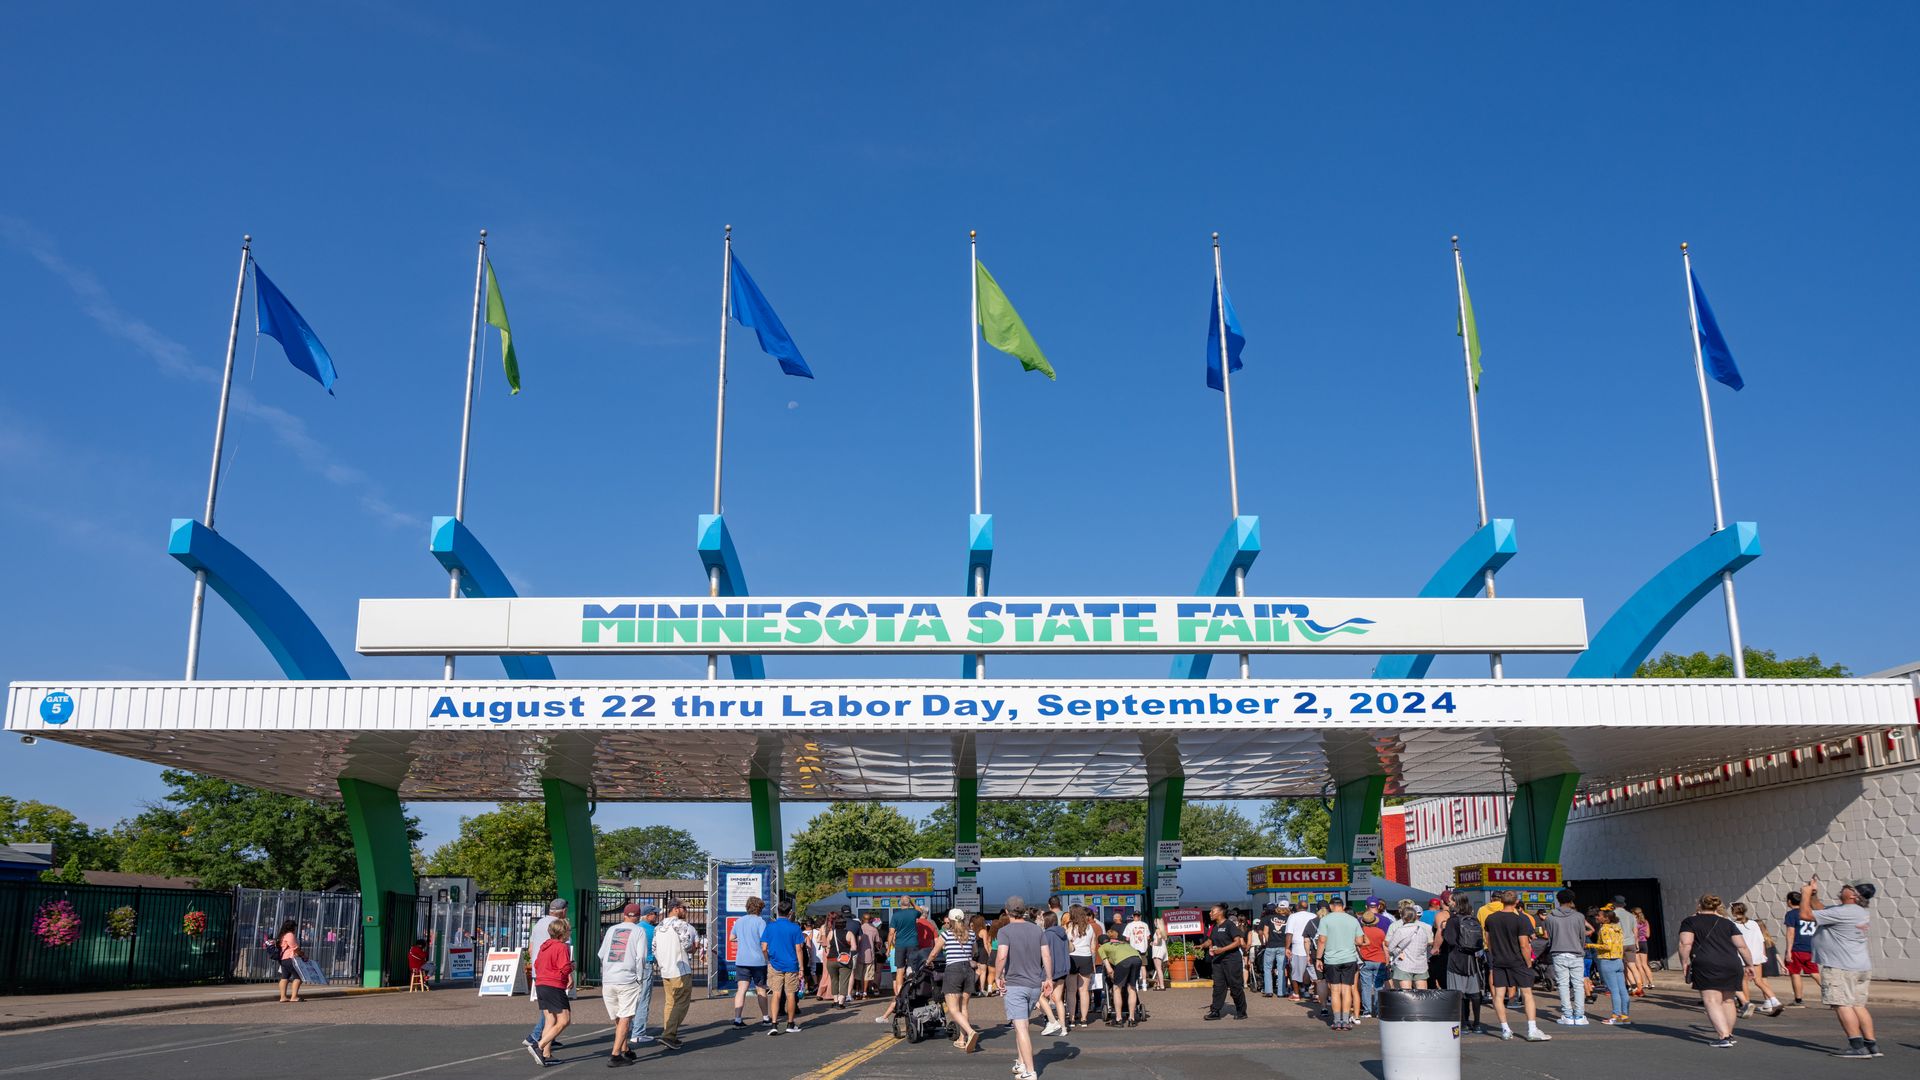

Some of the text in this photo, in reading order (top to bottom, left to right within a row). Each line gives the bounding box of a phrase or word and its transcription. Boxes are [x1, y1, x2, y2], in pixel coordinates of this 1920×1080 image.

[582, 601, 1340, 644] MINNESOTA STATE FAIR
[51, 703, 62, 714] 5
[429, 691, 1457, 724] August 22 thru Labor Day, September 2, 2024
[861, 875, 920, 886] TICKETS
[1072, 873, 1131, 884] TICKETS
[1279, 870, 1336, 881] TICKETS
[1494, 870, 1550, 881] TICKETS
[1799, 920, 1816, 936] 23
[490, 964, 511, 973] EXIT
[487, 975, 511, 983] ONLY
